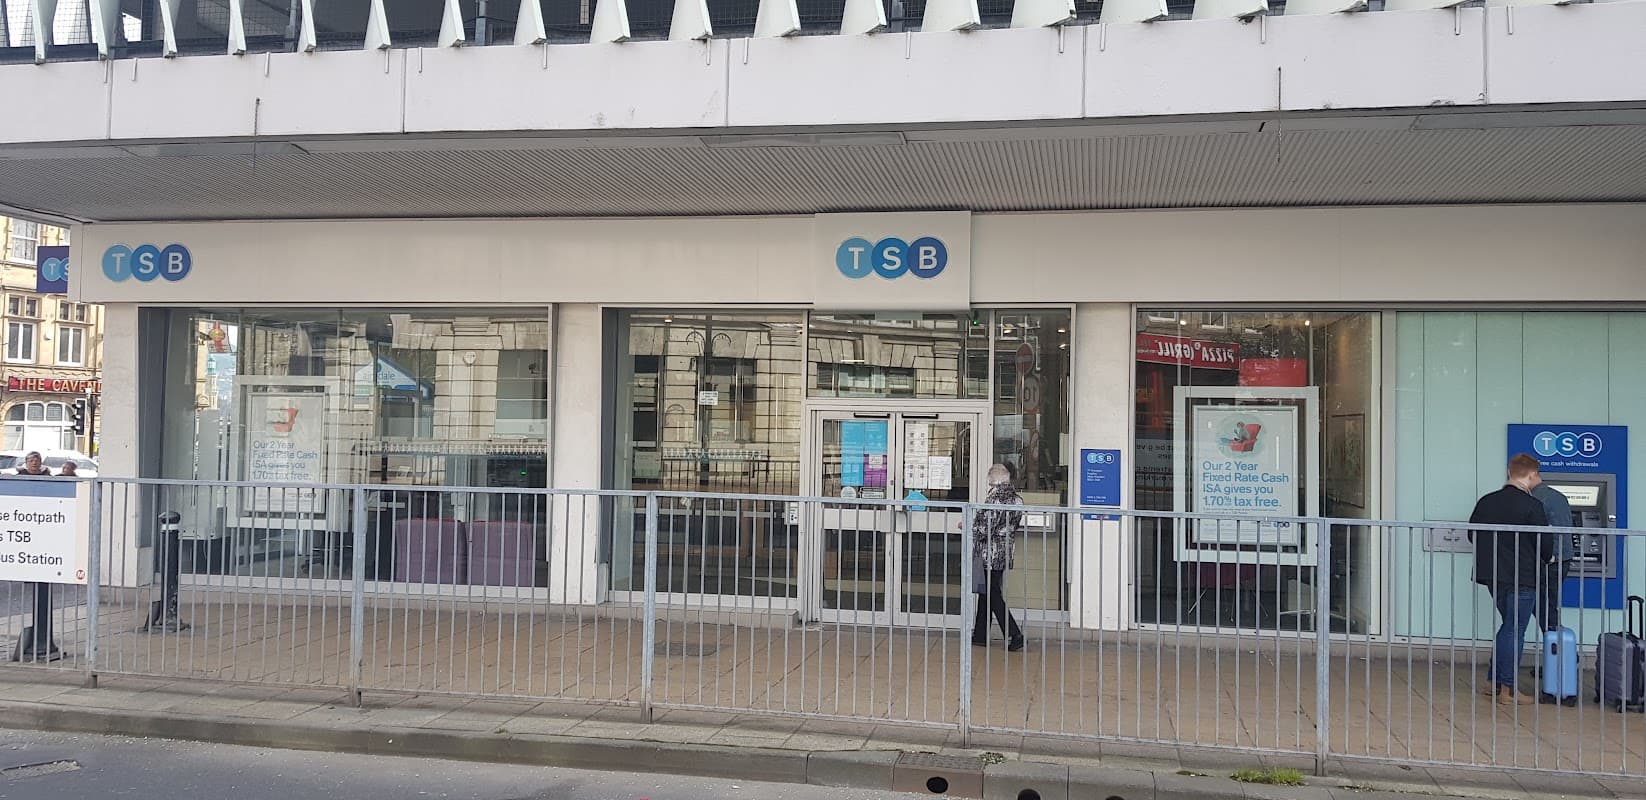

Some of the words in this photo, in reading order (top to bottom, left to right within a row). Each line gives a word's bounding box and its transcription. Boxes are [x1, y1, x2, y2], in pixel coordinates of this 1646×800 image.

[111, 252, 183, 275] TSB
[847, 245, 938, 271] TSB
[18, 378, 46, 391] THE
[1541, 437, 1596, 452] TSB
[1202, 460, 1224, 471] Our
[1225, 461, 1232, 471] 2
[1234, 461, 1258, 471] Year
[1202, 472, 1232, 481] Fixed
[1234, 472, 1259, 482] Rate
[1261, 472, 1289, 483] Cash
[1203, 483, 1222, 493] ISA
[1223, 484, 1252, 495] gives
[1254, 486, 1274, 495] you
[1234, 496, 1252, 507] tax
[1255, 496, 1282, 508] free.
[14, 509, 66, 525] footpath
[6, 530, 32, 543] TSB
[18, 551, 63, 566] Station
